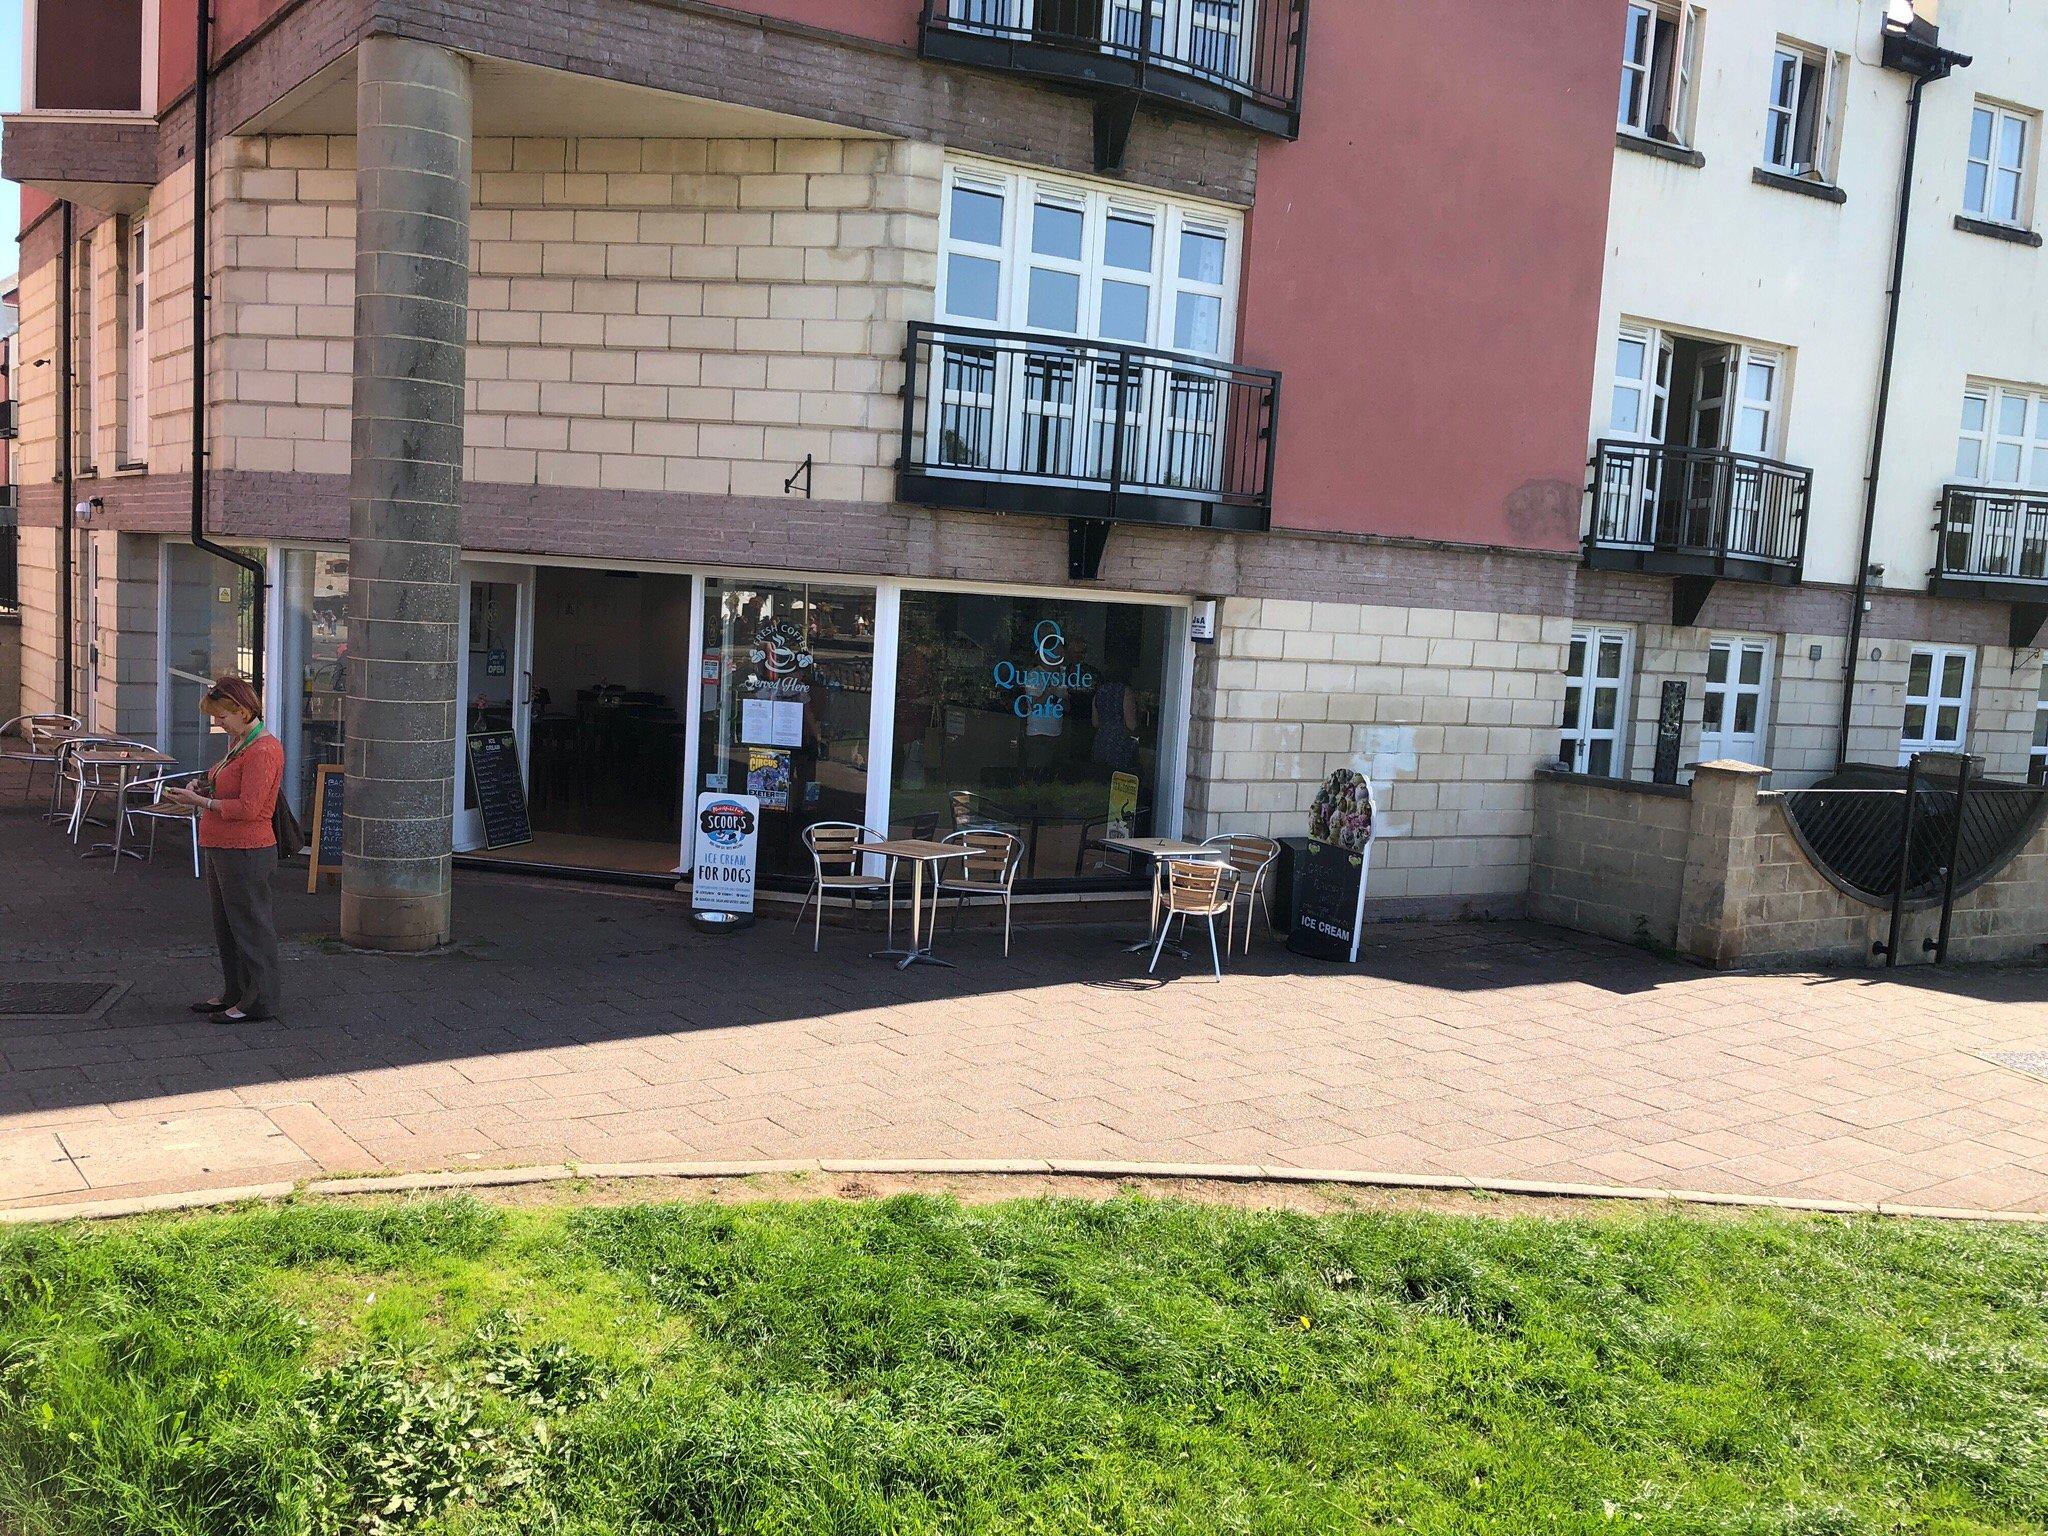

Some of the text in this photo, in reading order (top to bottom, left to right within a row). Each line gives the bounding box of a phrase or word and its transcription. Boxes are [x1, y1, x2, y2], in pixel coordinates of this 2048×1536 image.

[754, 624, 809, 652] FRESH COFFEE
[488, 665, 505, 673] OPEN
[993, 661, 1092, 692] Quayside
[744, 677, 810, 693] Served Here
[1014, 694, 1064, 719] Café
[750, 758, 778, 771] CIRCUS
[704, 853, 747, 866] ICE CREAM
[699, 866, 751, 883] FOR DOGS
[1302, 915, 1350, 941] ICE CREAM
